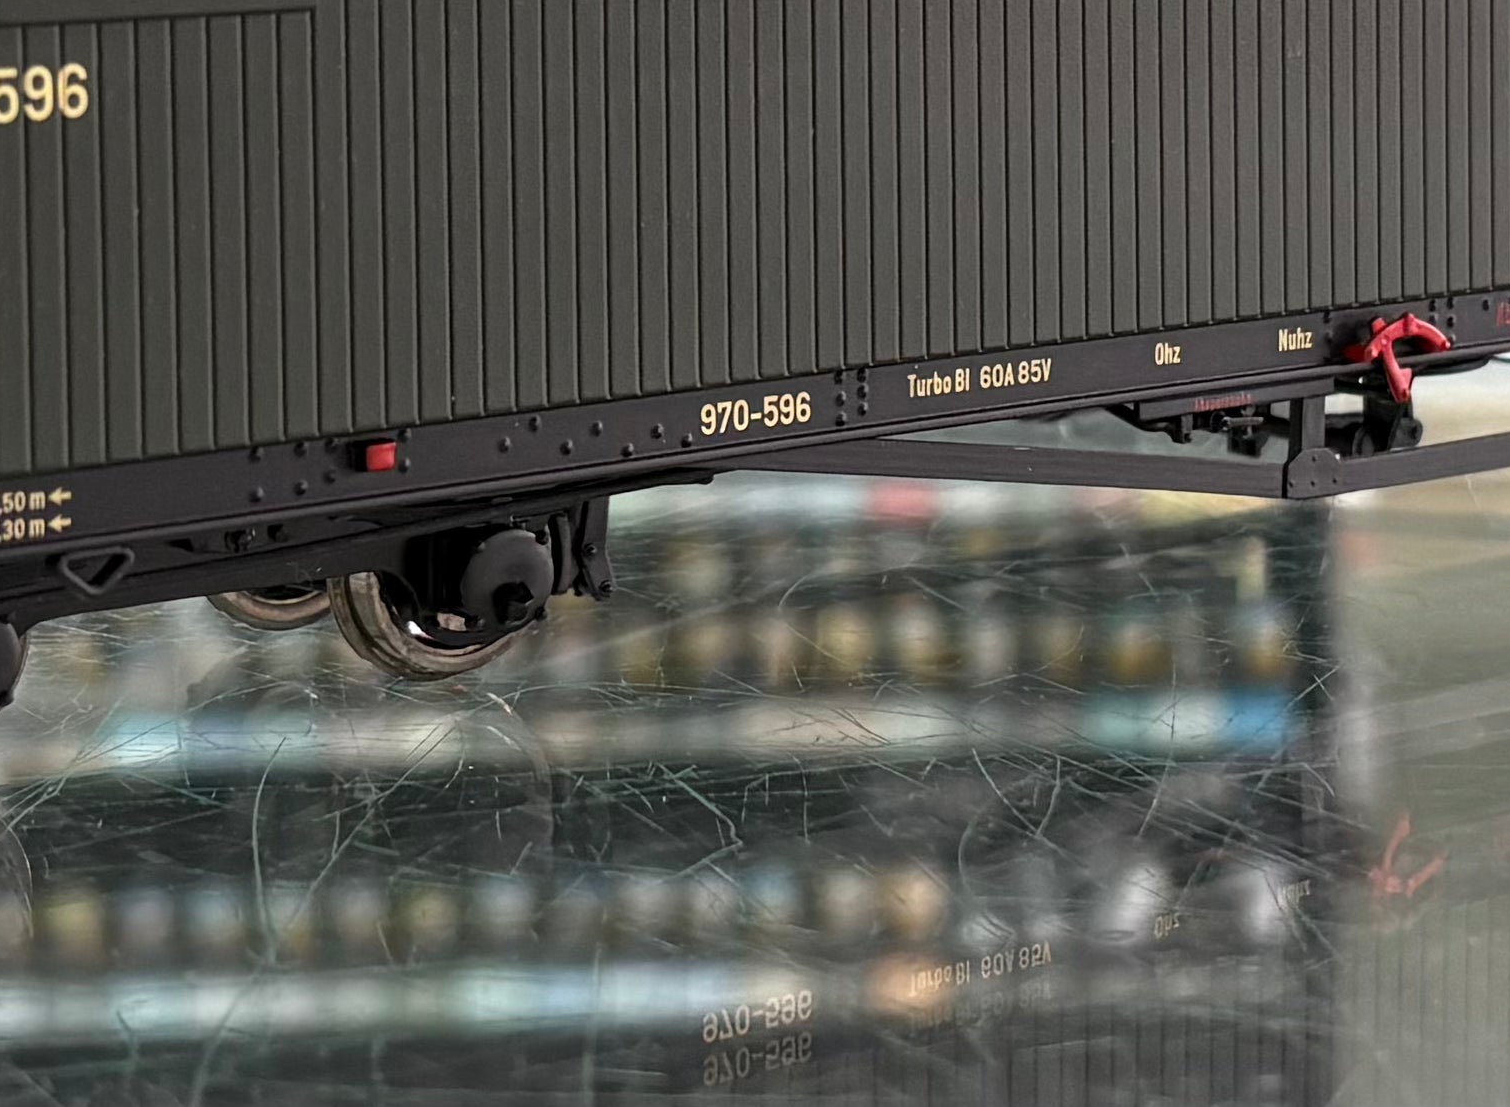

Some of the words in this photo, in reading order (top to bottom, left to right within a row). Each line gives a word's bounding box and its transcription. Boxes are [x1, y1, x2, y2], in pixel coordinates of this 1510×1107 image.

[1277, 326, 1314, 353] Nuhz
[907, 368, 953, 398] Turbo
[699, 391, 812, 436] 970-596
[29, 491, 46, 511] m
[29, 518, 46, 537] m
